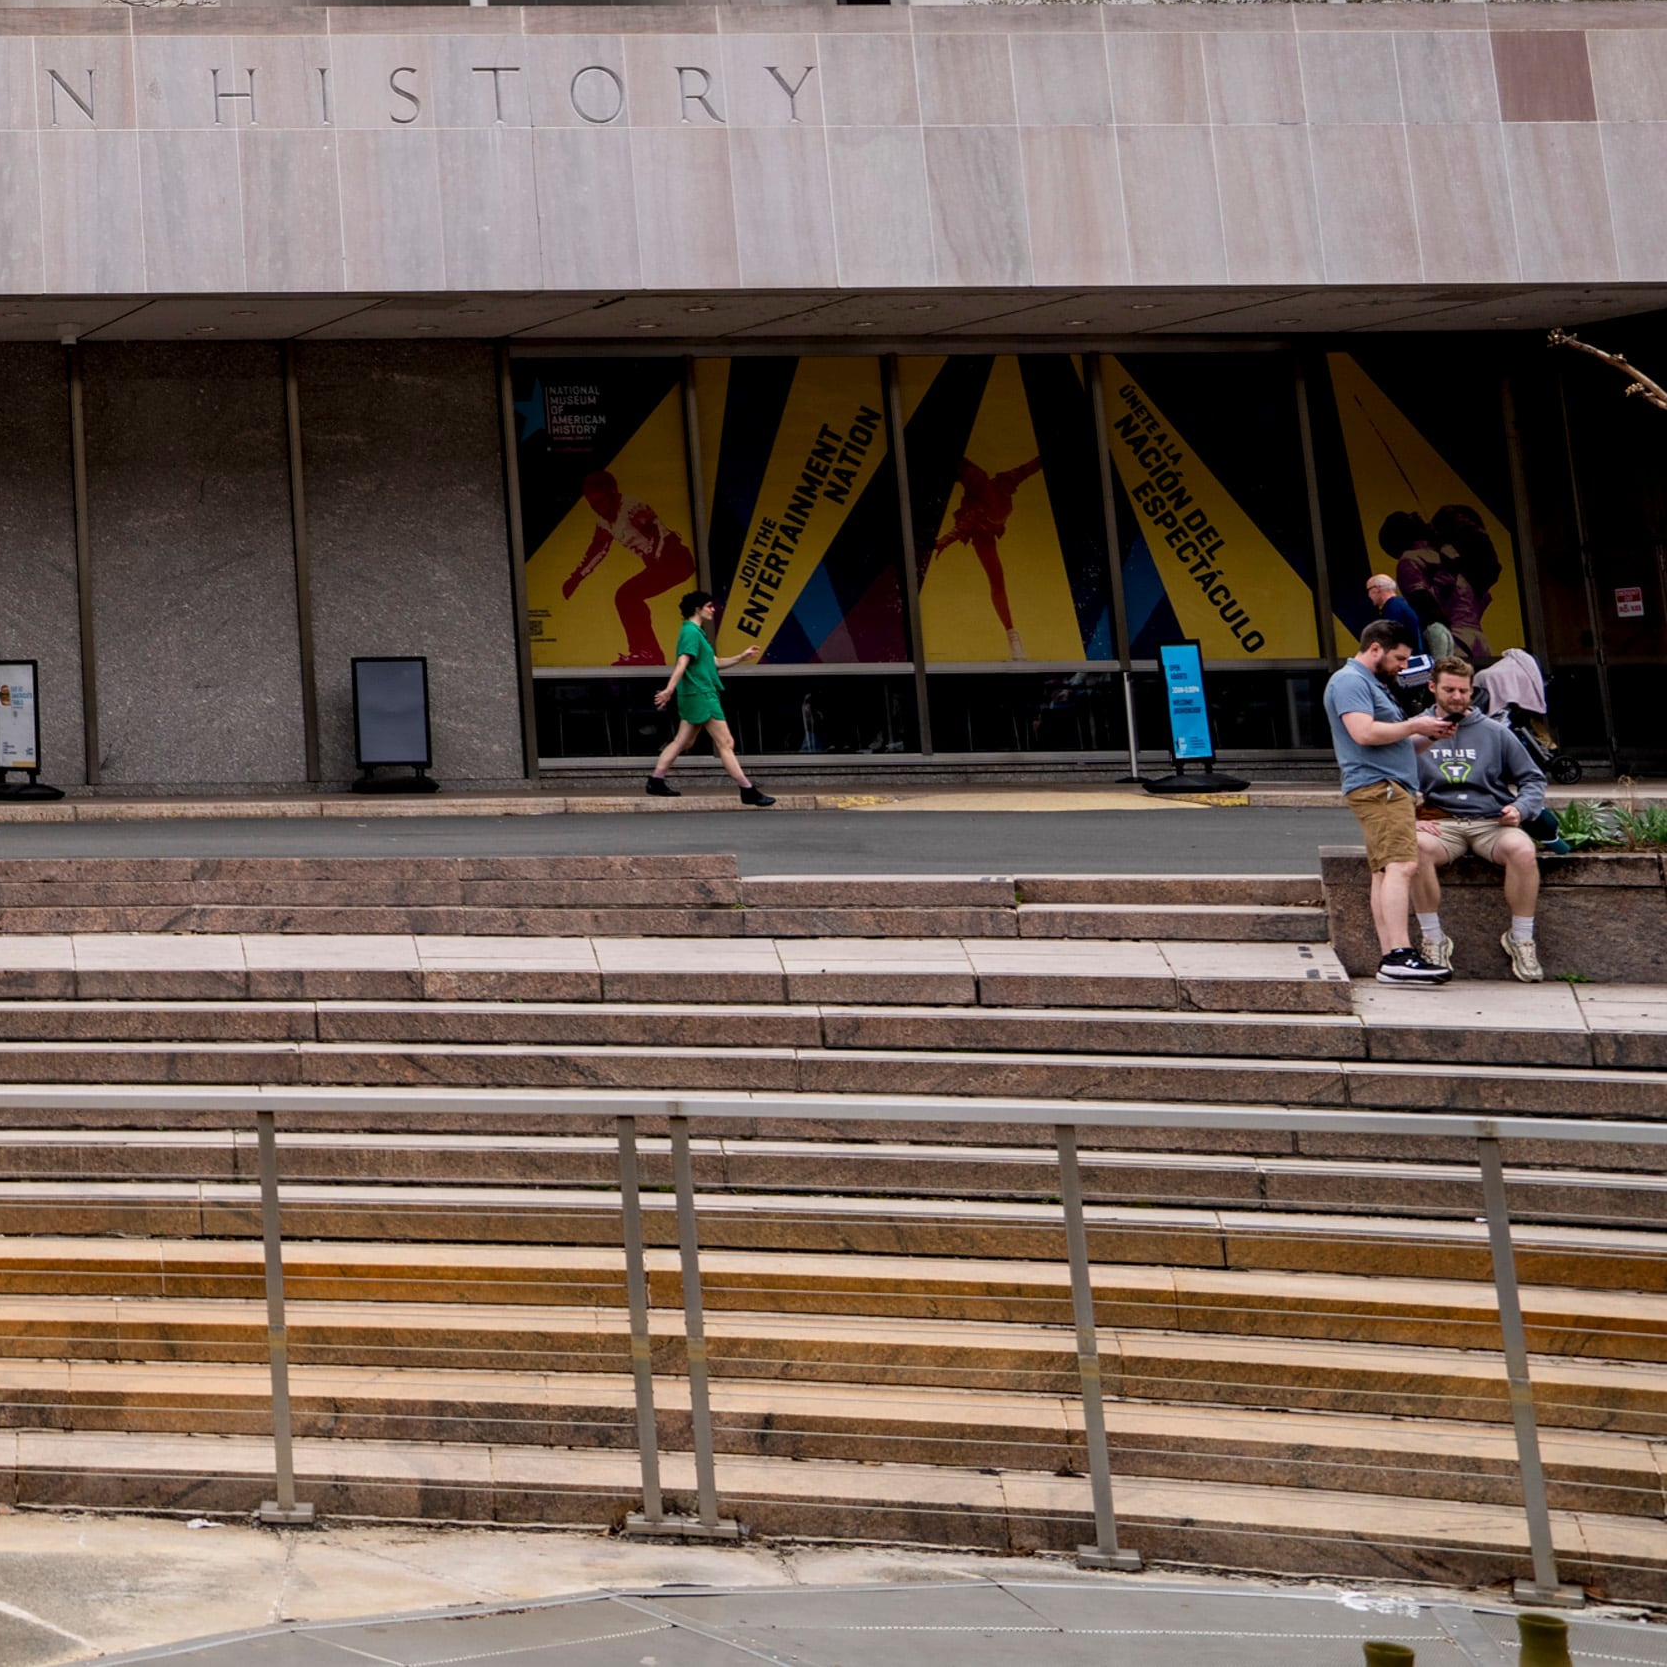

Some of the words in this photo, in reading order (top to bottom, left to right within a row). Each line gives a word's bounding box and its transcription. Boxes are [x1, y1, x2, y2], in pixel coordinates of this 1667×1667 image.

[210, 67, 814, 125] HISTORY
[549, 385, 601, 395] NATIONAL
[550, 395, 597, 405] MUSEUM
[550, 405, 564, 415] OF
[552, 415, 607, 425] AMERICAN
[552, 425, 597, 435] HISTORY
[1119, 384, 1161, 435] ÚNETE
[1154, 433, 1167, 446] A
[1163, 443, 1183, 466] LA
[823, 405, 883, 505] NATION
[1113, 413, 1193, 512] NACIÓN
[1182, 508, 1226, 561] DEL
[737, 423, 843, 638] ENTERTAINMENT
[739, 548, 764, 588] JOIN
[753, 516, 777, 548] THE
[1132, 480, 1265, 654] ESPECTÁCULO
[1429, 748, 1476, 760] TRUE
